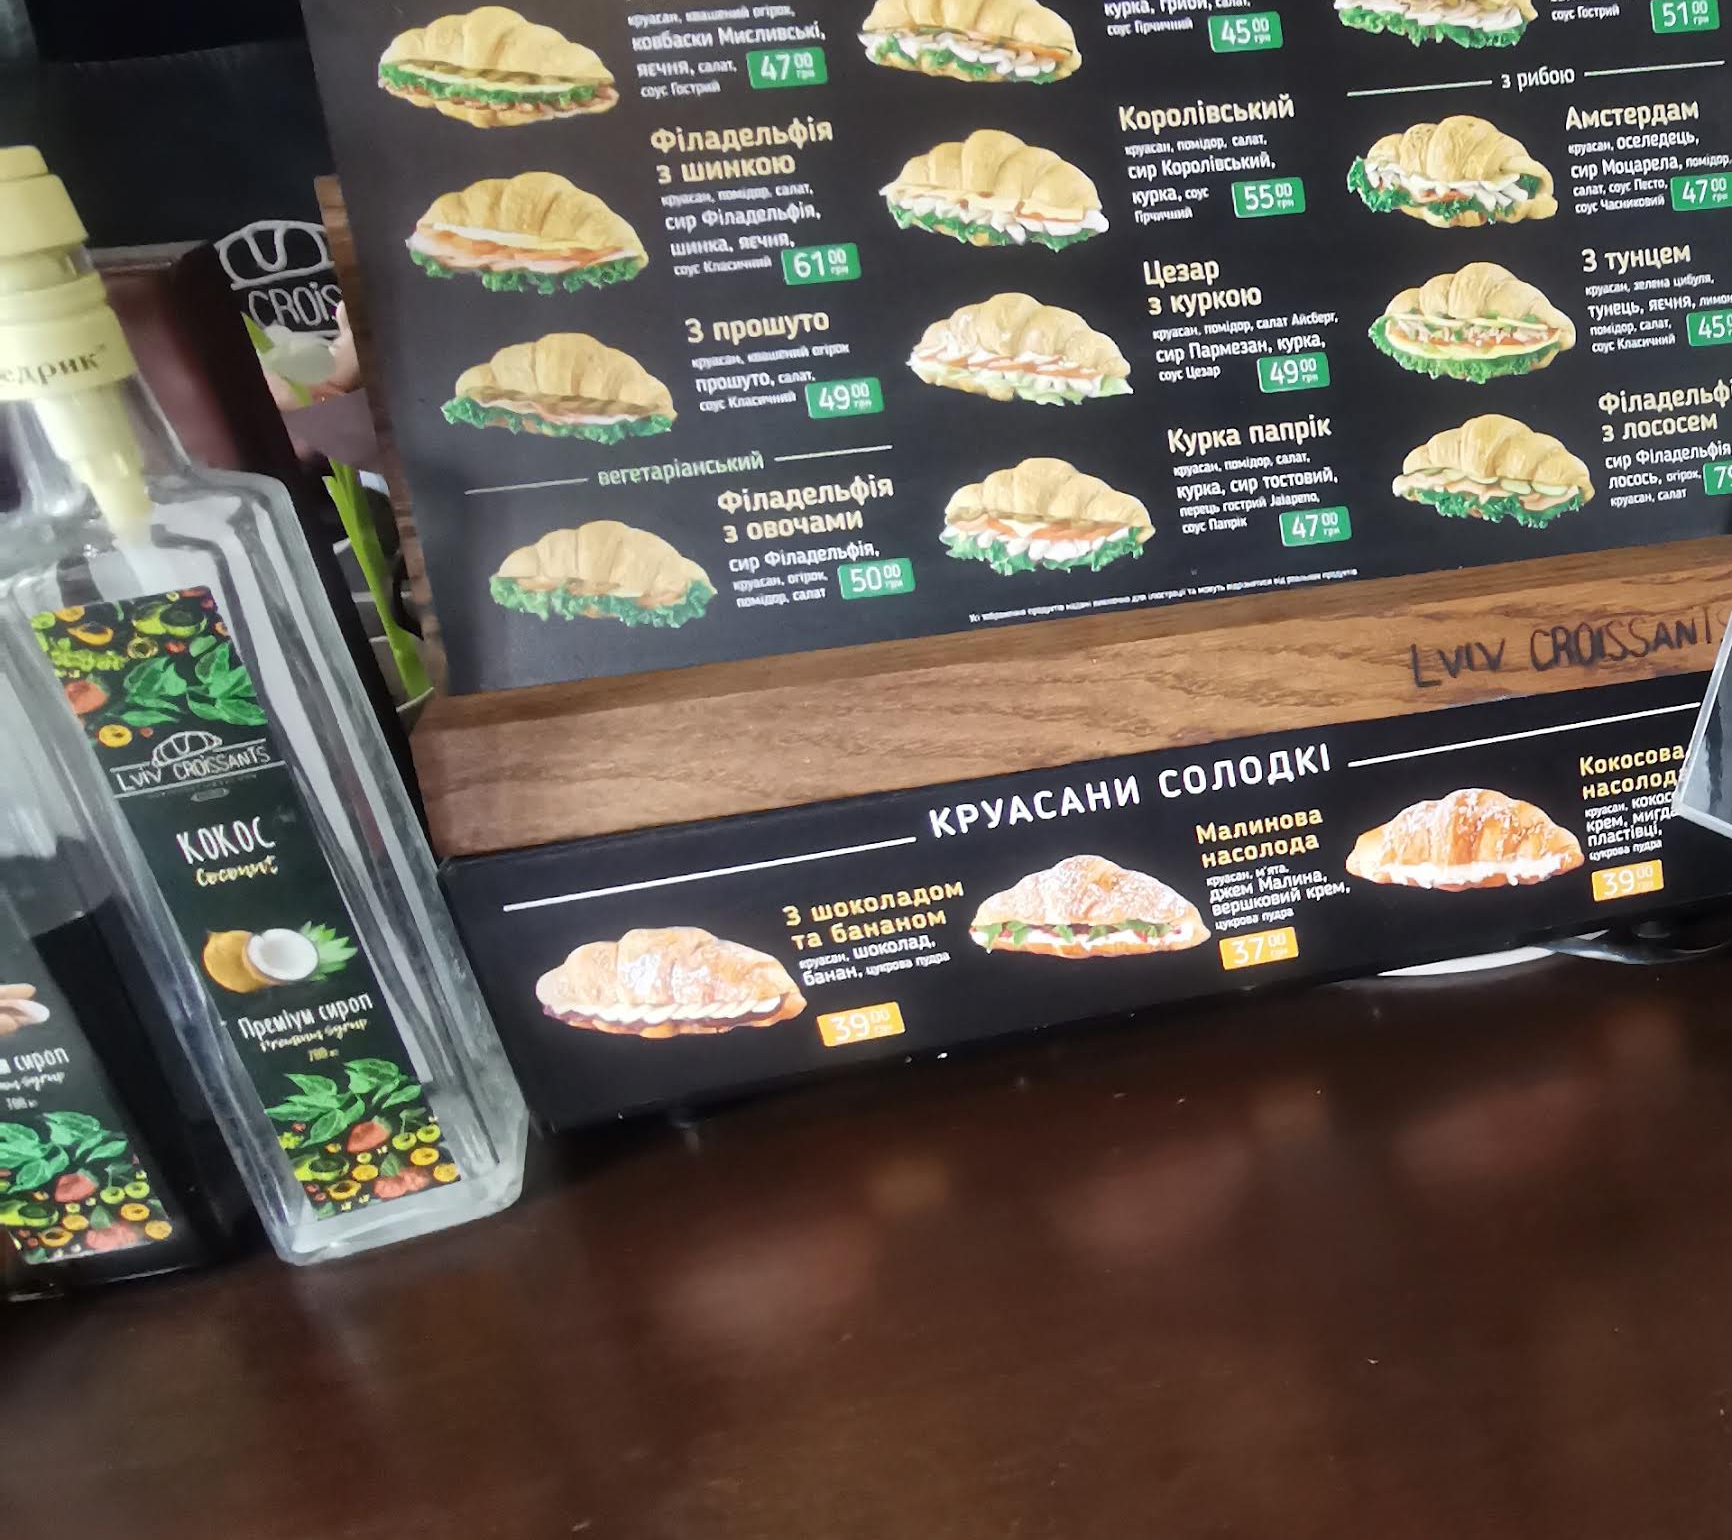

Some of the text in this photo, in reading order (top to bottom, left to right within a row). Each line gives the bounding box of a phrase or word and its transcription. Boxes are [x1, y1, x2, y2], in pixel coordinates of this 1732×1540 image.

[1516, 66, 1576, 94] рибою
[1117, 92, 1296, 137] Королівський
[1564, 99, 1701, 132] Амстердам
[649, 115, 835, 155] Філадельфія
[680, 153, 797, 183] шинкою
[1142, 258, 1222, 291] Цезар
[1604, 243, 1692, 276] тунцем
[1170, 285, 1263, 320] куркою
[712, 310, 831, 347] прошуто
[1166, 412, 1333, 458] Курка папрік
[1621, 410, 1720, 445] лососем
[597, 448, 766, 488] вегетаріанський
[716, 473, 896, 516] Філадельфія
[745, 509, 866, 542] овочами
[1408, 638, 1507, 689] LVIV
[1579, 744, 1686, 777] Кокосова
[926, 741, 1333, 841] КРУАСАНИ СОЛОДКІ
[1581, 768, 1680, 801] насолод
[176, 815, 277, 865] КОКОС
[1194, 806, 1325, 845] Малинова
[1200, 830, 1320, 869] насолода
[195, 854, 279, 887] Coconut
[810, 876, 965, 924] шоколадом
[790, 904, 948, 952] та бананом
[237, 991, 374, 1042] Преміум сироп
